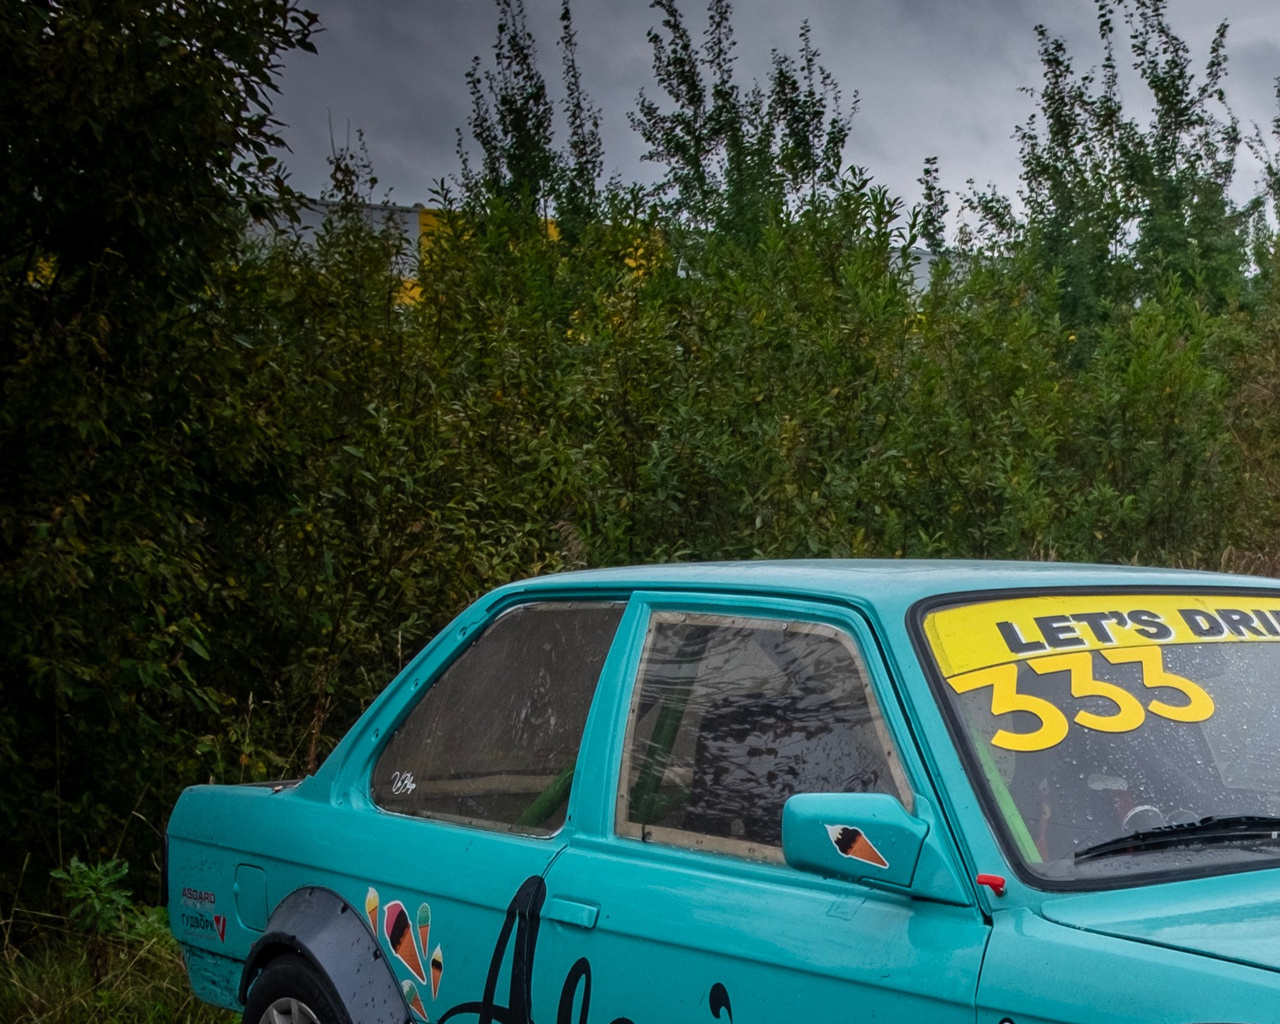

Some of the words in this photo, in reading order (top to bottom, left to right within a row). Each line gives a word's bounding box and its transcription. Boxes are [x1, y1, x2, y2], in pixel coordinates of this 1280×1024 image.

[995, 608, 1172, 655] LET'S
[946, 645, 1215, 752] 333
[181, 887, 216, 904] ASGARD
